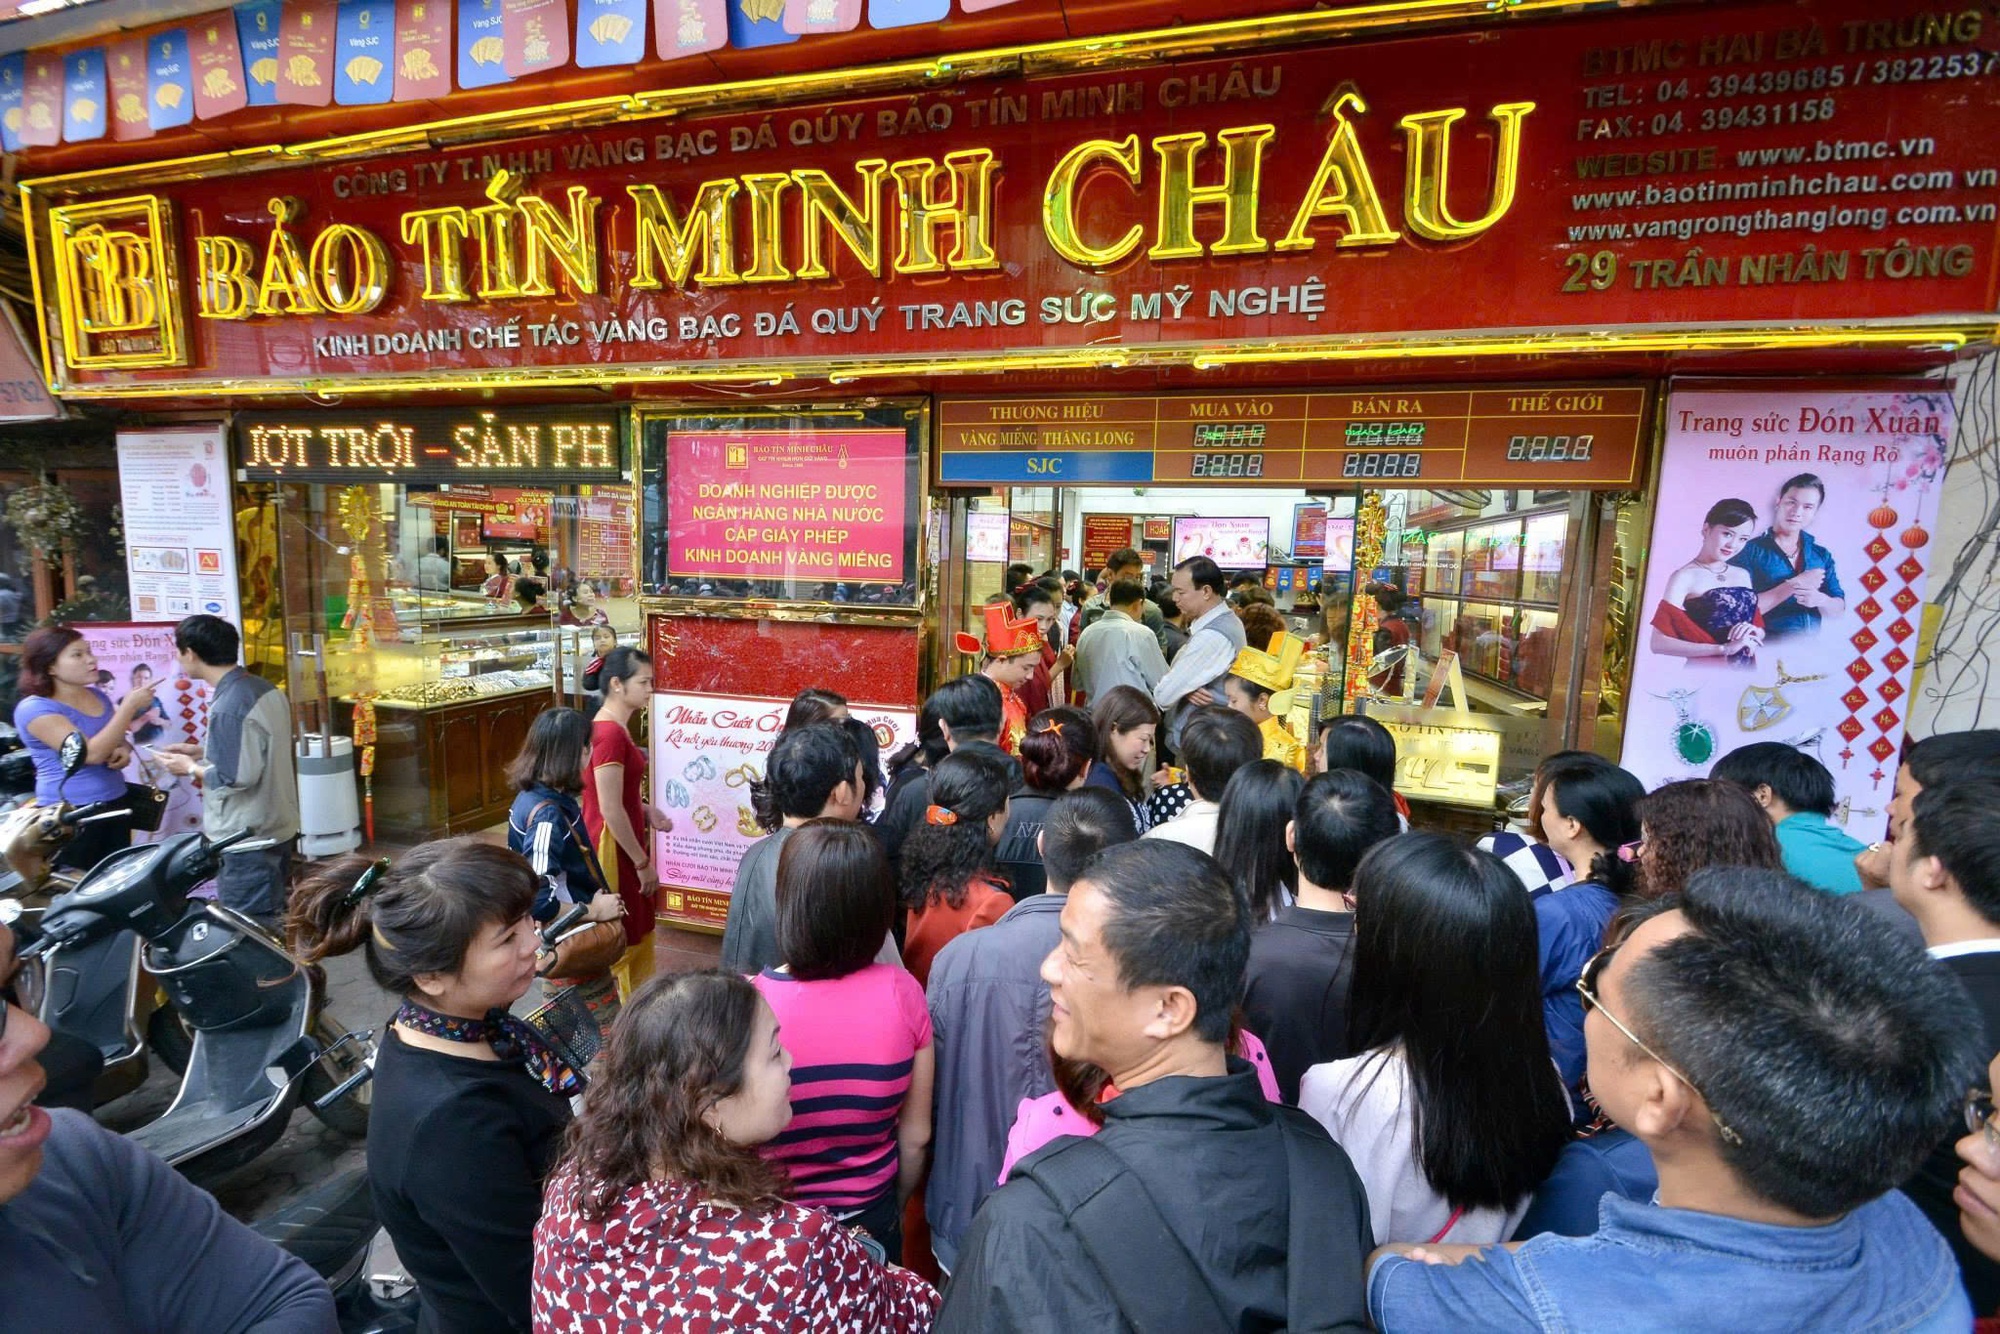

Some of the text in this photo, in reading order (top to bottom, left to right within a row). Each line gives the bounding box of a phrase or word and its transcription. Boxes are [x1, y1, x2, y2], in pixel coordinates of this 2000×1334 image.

[1699, 31, 1763, 67] HAI
[1583, 85, 1643, 110] TEL:
[333, 168, 408, 200] CÔNG
[418, 160, 449, 187] TY
[562, 135, 646, 172] VÀNG
[655, 129, 718, 165] BẠC
[730, 116, 778, 154] ĐÁ
[876, 94, 953, 138] BẢO
[965, 87, 1028, 130] TÍN
[1041, 81, 1145, 121] MINH
[1158, 62, 1283, 108] CHÂU
[1577, 116, 1644, 142] FAX:
[1736, 137, 1936, 170] www.btmc.vn
[195, 92, 1537, 321] BẢO TÍN MINH CHÂU
[1562, 237, 1975, 292] 29 TRẦN NHÂN TÔNG
[313, 277, 1328, 359] KINH DOANH CHẾ TÁC VÀNG BẠC ĐÁ QUÝ TRANG SỨC MỸ NGHỆ
[989, 403, 1105, 422] THƯƠNG HIỆU
[1189, 398, 1274, 418] MUA VÀO
[1351, 396, 1424, 415] BÁN RA
[1507, 391, 1604, 413] THẾ GIỚI
[1678, 407, 1941, 436] Trang sức Đón Xuân
[453, 412, 540, 469] SẢN
[551, 425, 616, 469] PH
[960, 426, 1135, 447] VÀNG MIẾNG THĂNG LONG
[1708, 444, 1759, 461] muôn
[1765, 440, 1811, 464] phần
[1817, 445, 1866, 466] Rạng
[1026, 457, 1064, 475] SJC
[699, 482, 877, 503] DOANH NGHIỆP ĐƯỢC
[692, 503, 884, 523] NGÂN HÀNG NHÀ NƯỚC
[725, 525, 849, 544] CẤP GIẤY PHÉP
[685, 549, 892, 568] KINH DOANH VÀNG MIẾNG
